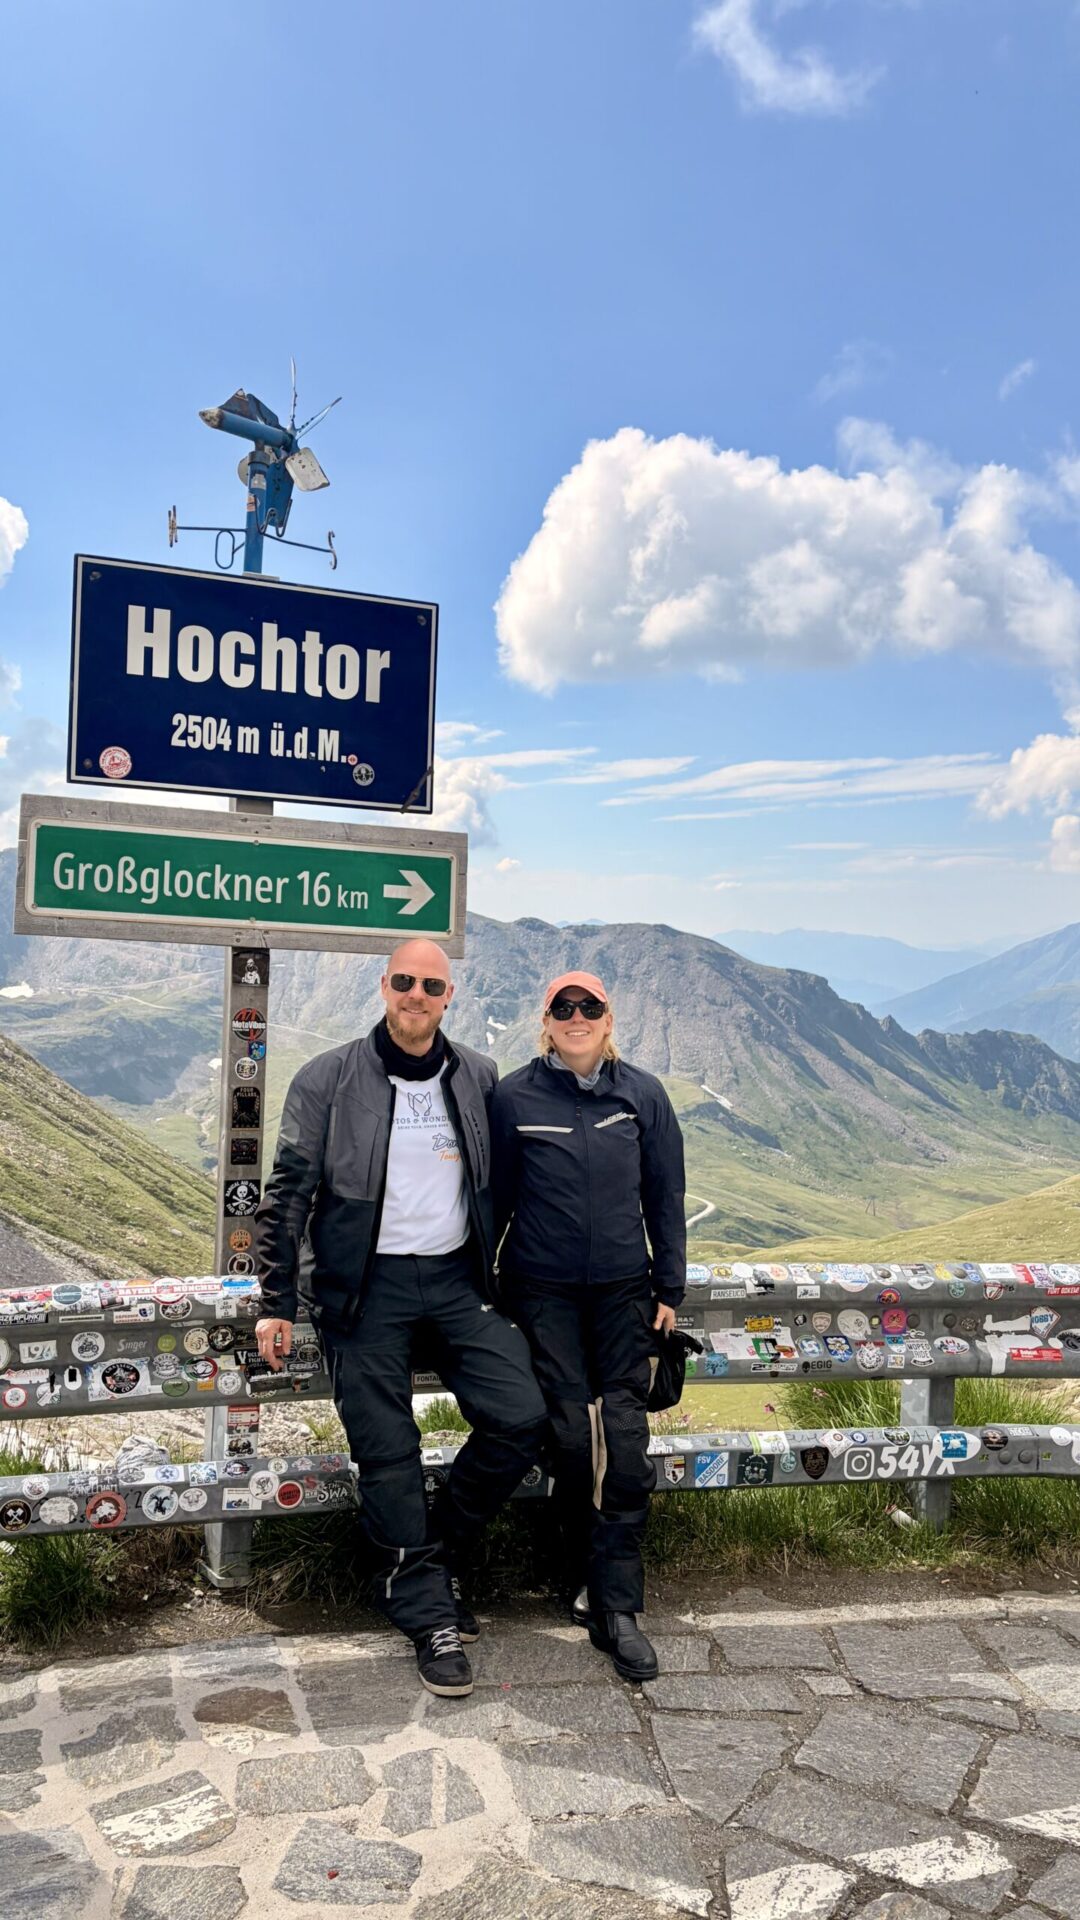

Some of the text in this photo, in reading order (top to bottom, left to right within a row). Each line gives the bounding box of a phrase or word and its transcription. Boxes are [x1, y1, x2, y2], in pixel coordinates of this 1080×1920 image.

[126, 604, 391, 703] Hochtor
[171, 713, 231, 751] 2504
[237, 726, 260, 756] m
[53, 852, 369, 910] Großglockner 16 km
[117, 1338, 148, 1352] Singer
[697, 1456, 711, 1464] FSV
[698, 1455, 726, 1485] BASDORF
